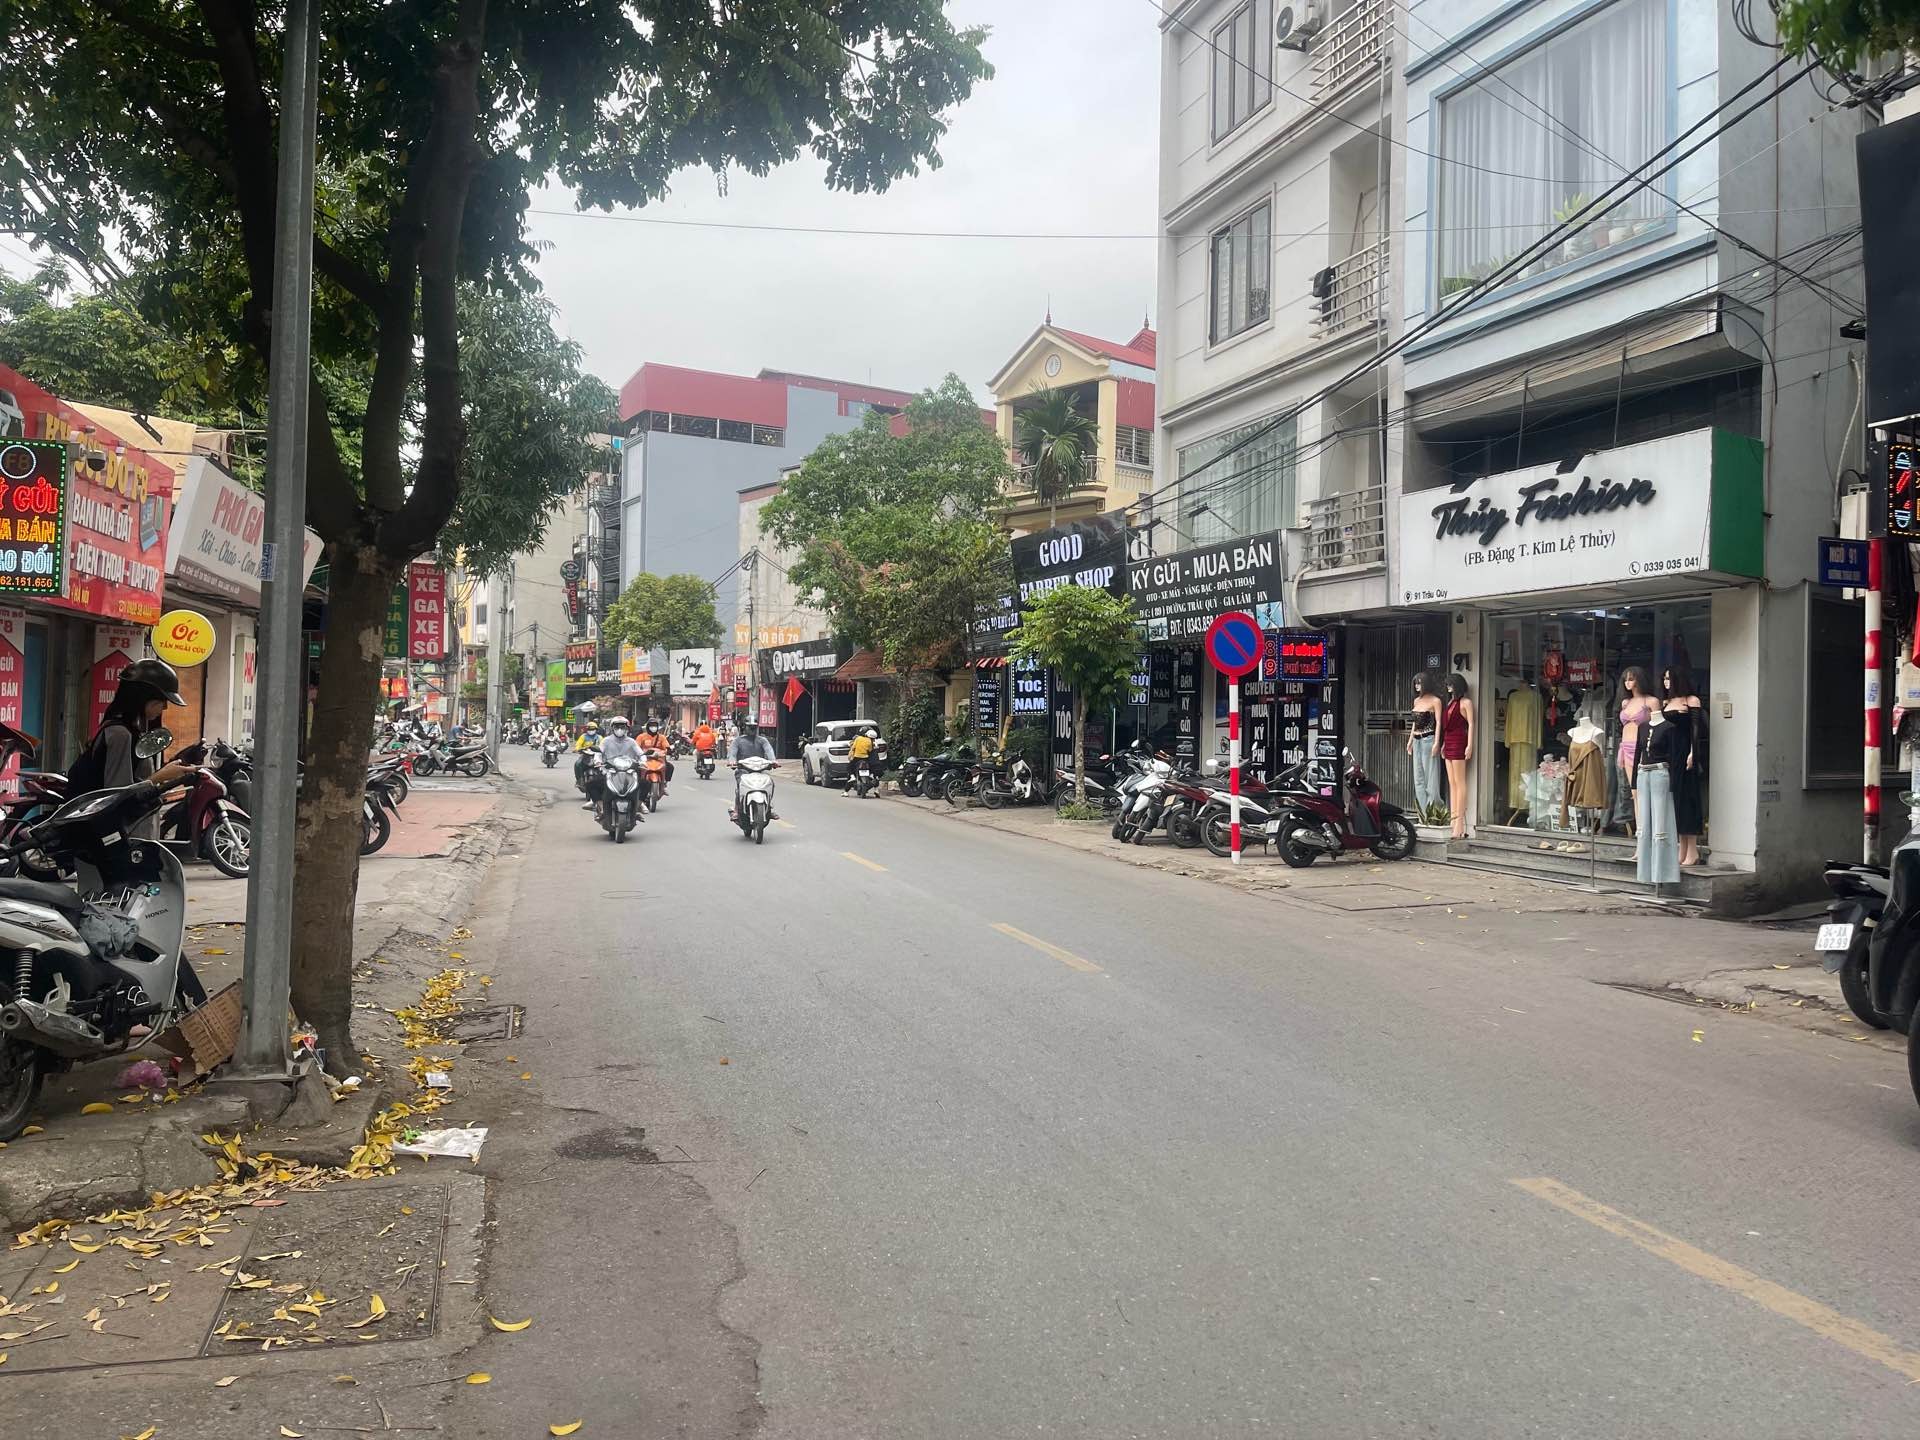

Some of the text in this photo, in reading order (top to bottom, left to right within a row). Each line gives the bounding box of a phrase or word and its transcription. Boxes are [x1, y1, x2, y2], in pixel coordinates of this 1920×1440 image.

[13, 476, 59, 514] GỬI
[1515, 476, 1657, 527] Fashion
[212, 486, 249, 536] PHỞ
[17, 516, 55, 544] BÁN
[1039, 533, 1083, 567] GOOD
[1488, 546, 1515, 565] Đặng
[1519, 543, 1530, 557] T.
[1533, 540, 1556, 556] Kim
[1560, 534, 1576, 553] Lệ
[1131, 538, 1273, 591] KÝ GỬI MUA BÁN
[1643, 556, 1700, 573] 0339 035 041
[415, 577, 440, 593] XE
[1075, 565, 1114, 590] SHOP
[414, 598, 439, 614] GA
[415, 619, 439, 635] XE
[109, 637, 130, 649] F8
[413, 636, 439, 655] SỐ
[1429, 656, 1439, 666] 89
[1453, 652, 1472, 672] 91
[1, 683, 18, 697] BÁN
[1323, 684, 1332, 704] KÝ
[1, 702, 17, 722] ĐẤT
[1014, 698, 1046, 711] NAM
[1251, 702, 1301, 718] MUA BÁN
[1055, 704, 1072, 740] TÓC
[1321, 709, 1333, 731] GỬI
[1254, 720, 1299, 742] KÝ GỬI
[1282, 745, 1304, 765] THẤP
[144, 907, 169, 920] HONDA
